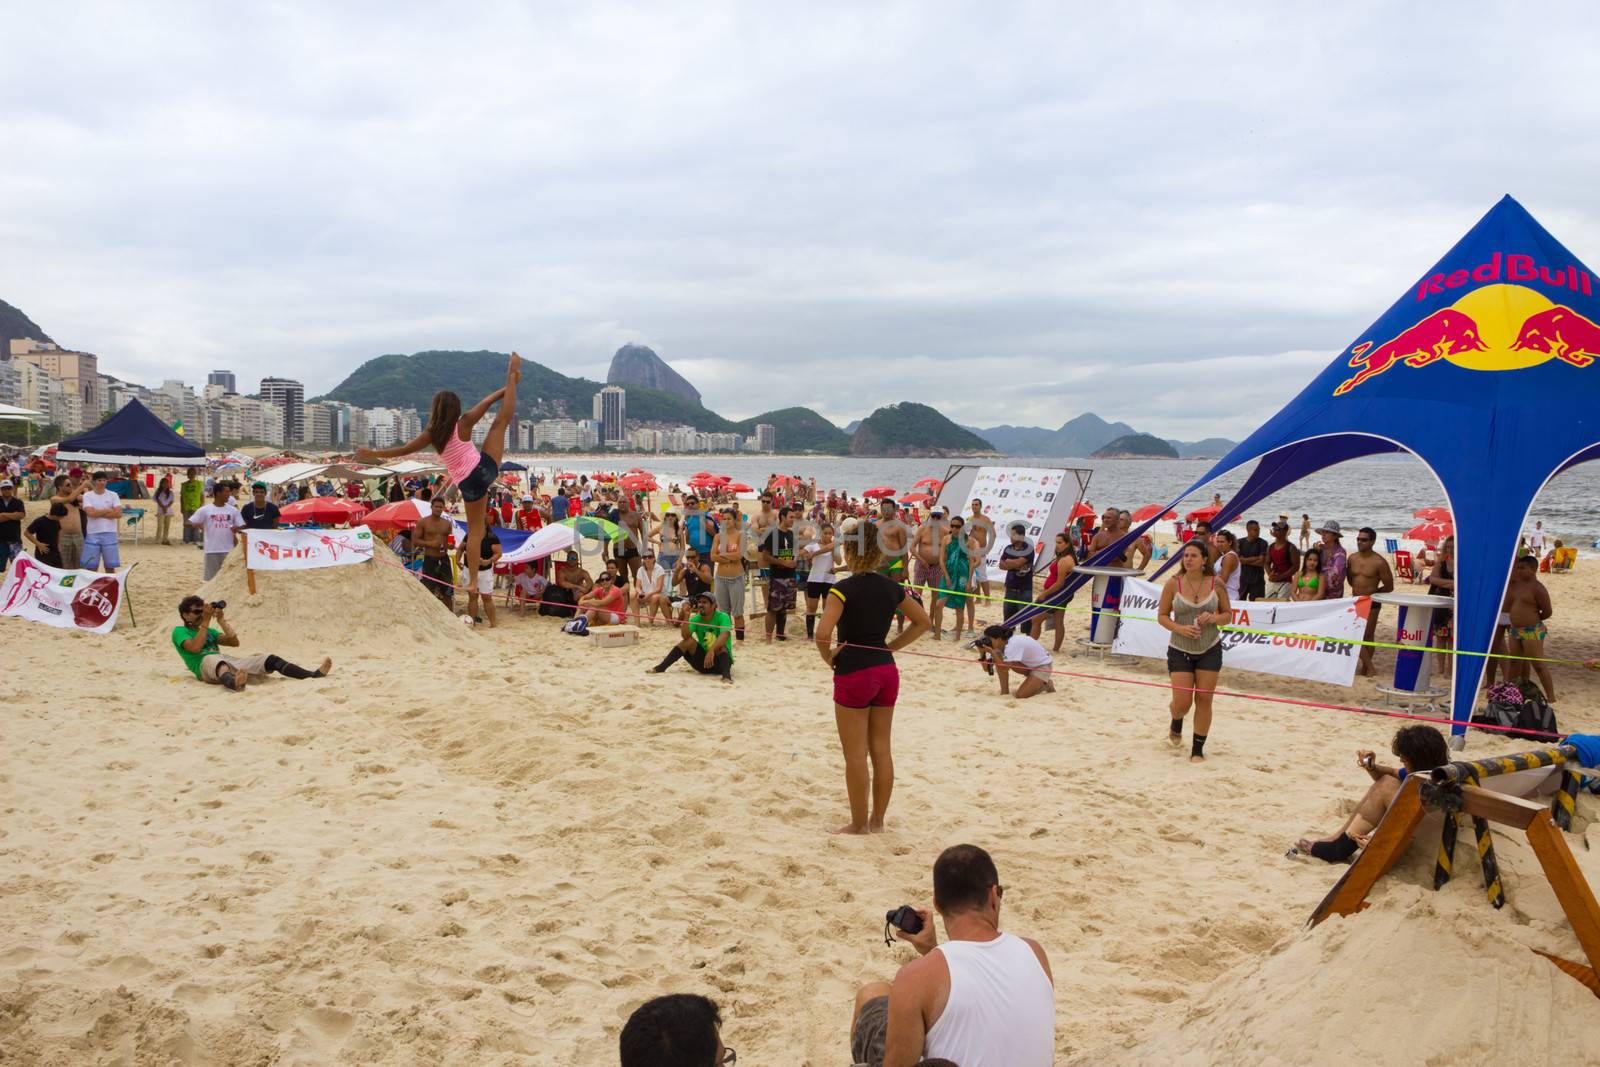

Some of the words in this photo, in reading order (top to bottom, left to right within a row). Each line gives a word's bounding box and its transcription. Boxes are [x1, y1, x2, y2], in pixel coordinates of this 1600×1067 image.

[1416, 252, 1502, 303] Red
[1506, 254, 1592, 297] Bull
[1401, 629, 1422, 641] Bull
